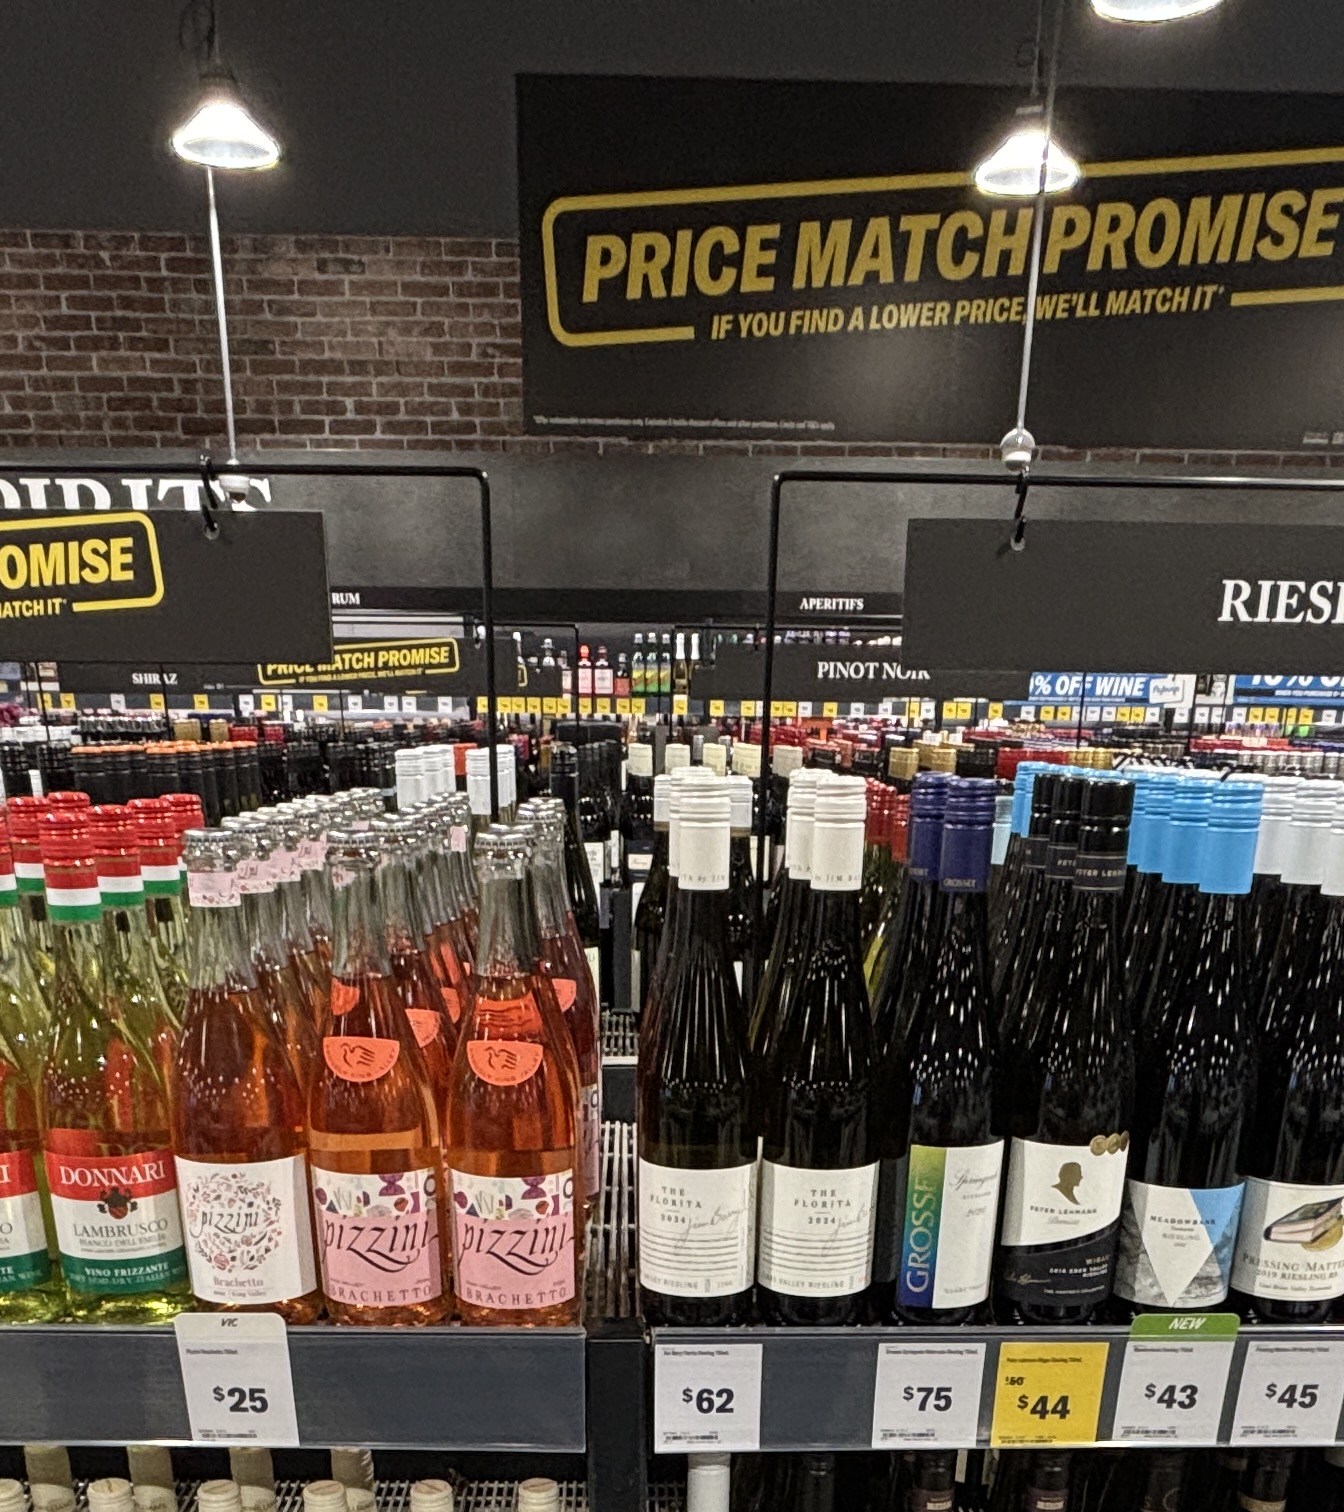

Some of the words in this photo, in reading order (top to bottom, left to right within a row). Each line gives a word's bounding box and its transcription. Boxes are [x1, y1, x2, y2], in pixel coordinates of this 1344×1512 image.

[582, 223, 781, 304] PRICE
[792, 207, 1034, 290] MATCH
[710, 314, 733, 340] IF
[739, 311, 787, 338] YOU
[789, 307, 845, 335] FIND
[849, 306, 865, 332] A
[870, 301, 951, 330] LOWER
[1035, 291, 1100, 320] WE'LL
[1104, 286, 1192, 316] MATCH
[332, 592, 360, 605] RUM
[800, 597, 864, 611] APERITIFS
[378, 646, 450, 668] PROMISE
[817, 661, 879, 679] PINOT
[1095, 676, 1147, 697] WINE
[60, 1160, 166, 1187] DONNARI
[72, 1219, 169, 1238] LAMBRUSCO
[330, 1285, 433, 1303] BRACHETTO
[465, 1286, 567, 1306] BRACHETTO
[1169, 1317, 1206, 1331] NEW
[213, 1386, 268, 1414] $25
[682, 1387, 735, 1415] $62
[903, 1385, 953, 1412] $75
[1017, 1393, 1070, 1420] $44
[1144, 1383, 1198, 1410] $43
[1265, 1383, 1319, 1410] $45
